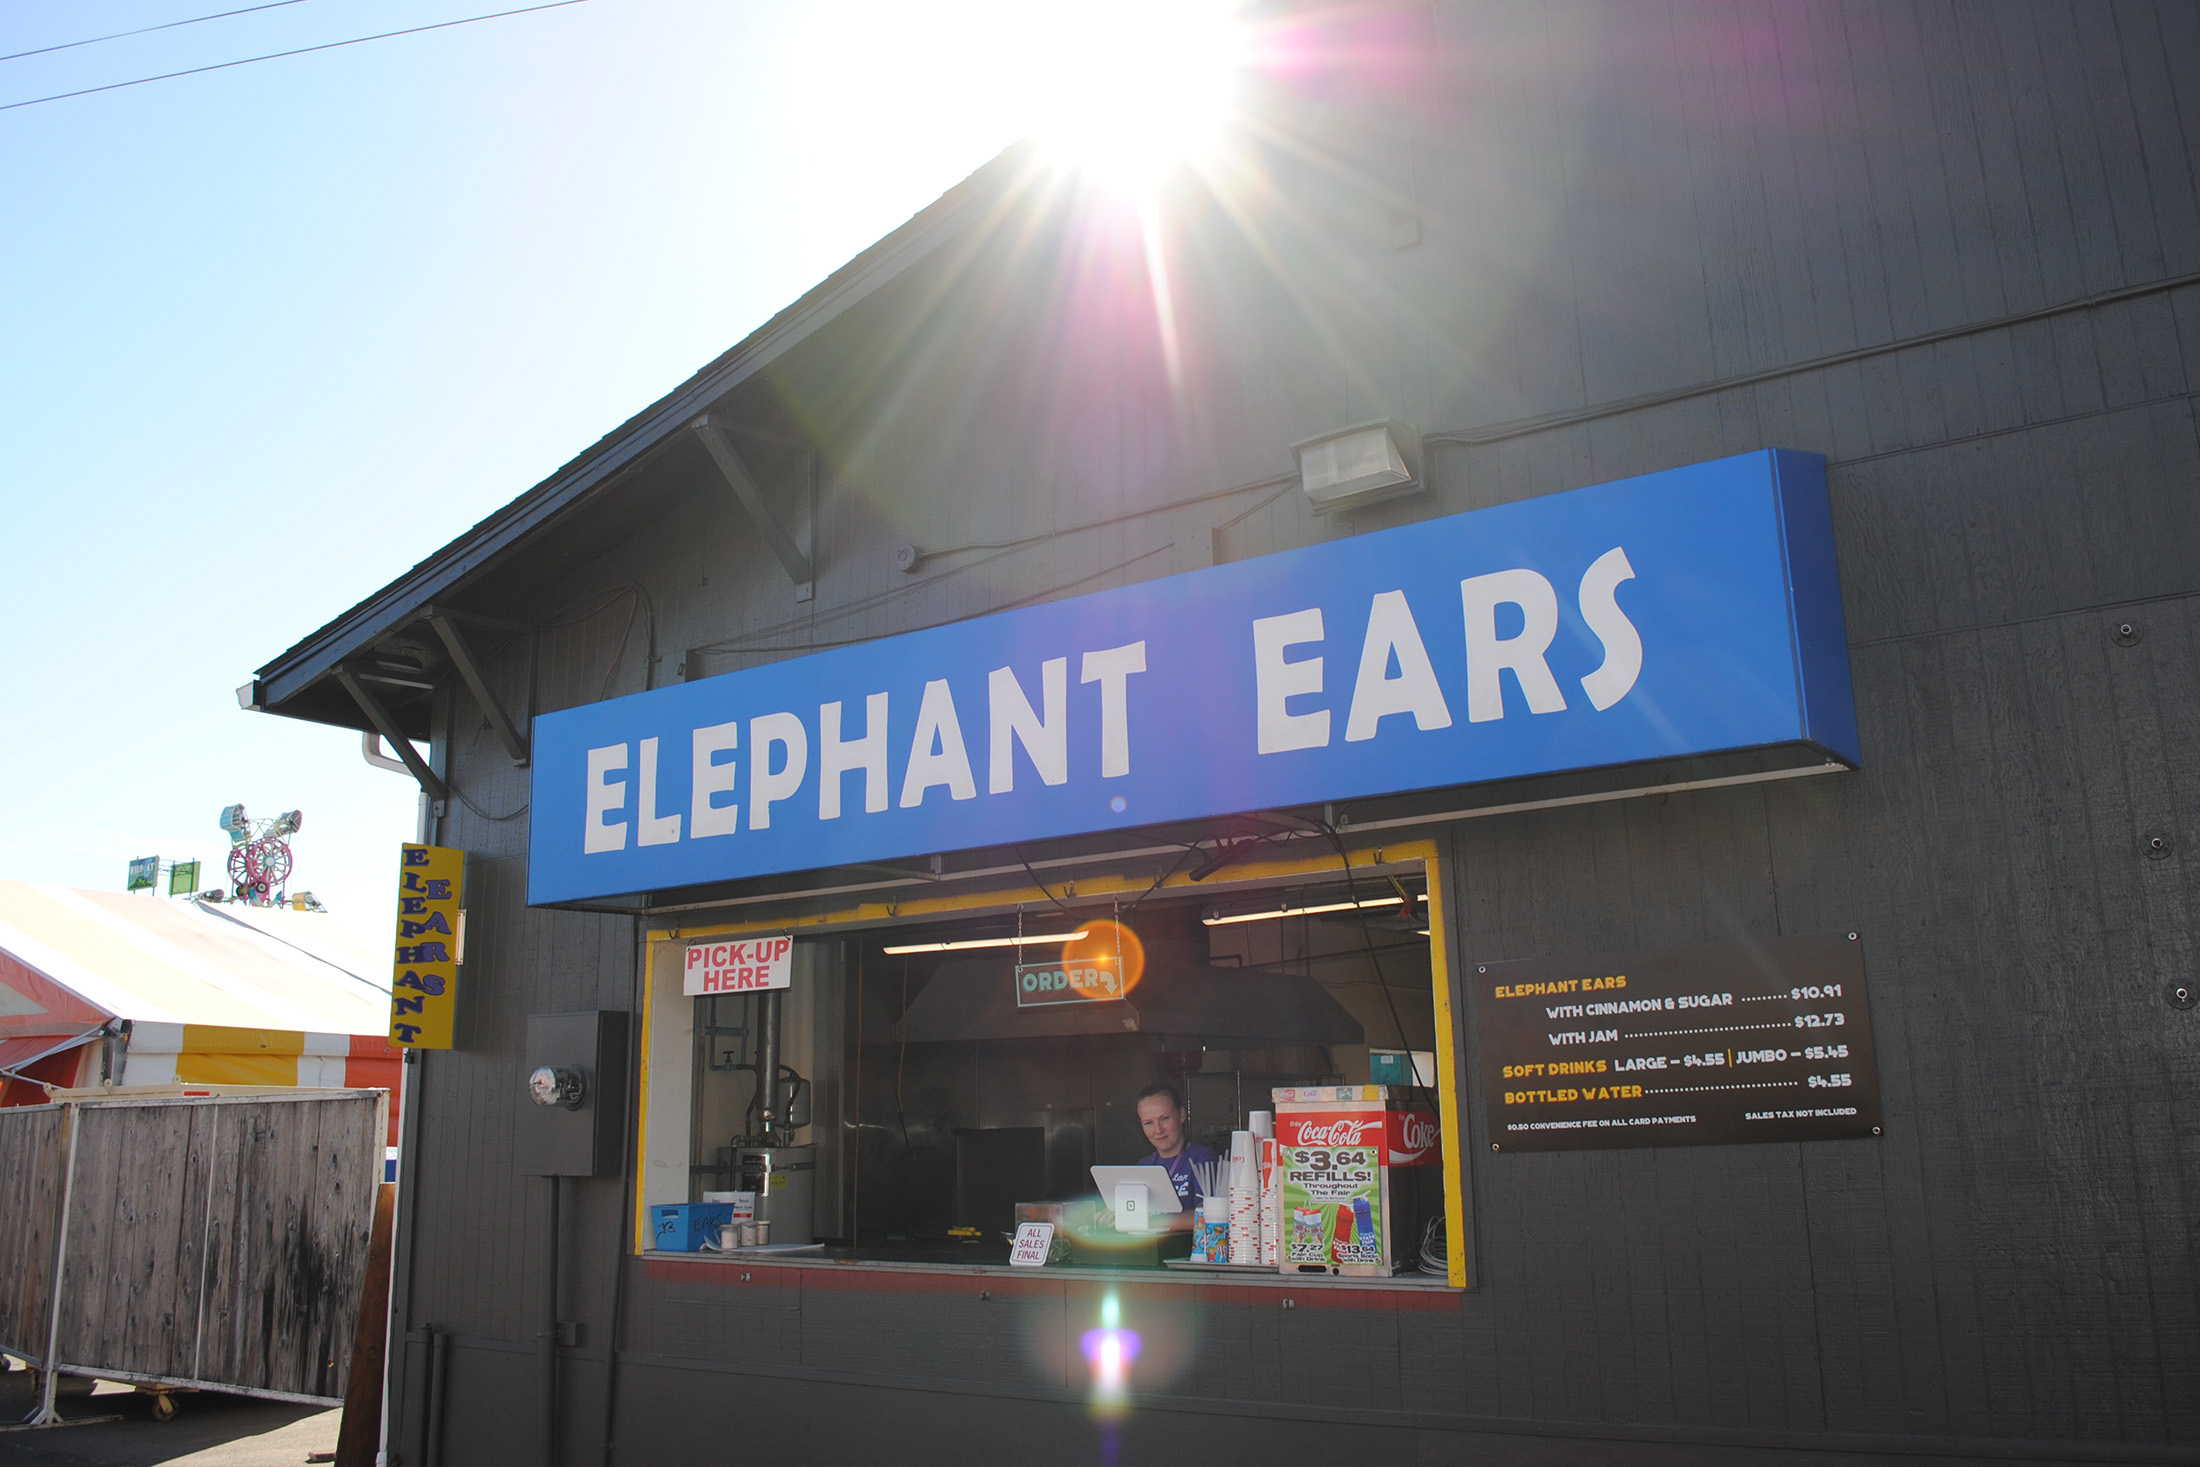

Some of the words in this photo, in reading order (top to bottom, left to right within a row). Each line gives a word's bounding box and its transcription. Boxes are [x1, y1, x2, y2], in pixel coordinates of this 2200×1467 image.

[584, 640, 1147, 854] ELEPHANT
[1253, 546, 1642, 754] EARS
[394, 849, 430, 1043] ELEPHANT
[420, 879, 452, 996] EARS
[688, 939, 789, 970] PICK-UP
[703, 965, 770, 992] HERE
[1022, 968, 1098, 992] ORDER
[1495, 980, 1578, 998] ELEPHANT
[1582, 975, 1627, 992] EARS
[1546, 1005, 1583, 1019] WITH
[1586, 999, 1662, 1016] CINNAMON
[1664, 998, 1675, 1010] &
[1678, 993, 1733, 1009] SUGAR
[1791, 984, 1843, 1000] $10.91
[1549, 1032, 1586, 1046] WITH
[1589, 1029, 1618, 1043] JAM
[1794, 1013, 1845, 1028] $12.73
[1502, 1064, 1545, 1078] SOFT
[1549, 1060, 1607, 1075] DRINKS
[1614, 1057, 1667, 1071] LARGE
[1684, 1053, 1725, 1067] $4.55
[1736, 1049, 1787, 1064] JUMBO
[1805, 1045, 1849, 1060] $5.45
[1504, 1089, 1578, 1104] BOTTLED
[1581, 1085, 1643, 1100] WATER
[1808, 1074, 1852, 1088] $4.55
[1507, 1123, 1528, 1131] $0.50
[1530, 1121, 1581, 1131] CONVENIENCE
[1582, 1119, 1598, 1128] FEE
[1599, 1118, 1610, 1127] ON
[1611, 1117, 1628, 1126] ALL
[1629, 1116, 1651, 1125] CARD
[1652, 1114, 1697, 1124] PAYMENTS
[1745, 1111, 1774, 1120] SALES
[1775, 1110, 1795, 1119] TAX
[1796, 1109, 1813, 1118] NOT
[1814, 1107, 1857, 1117] INCLUDED
[1297, 1119, 1365, 1147] Coca-Cola
[1403, 1113, 1435, 1149] Coke
[1294, 1150, 1366, 1171] $3.64
[1289, 1171, 1371, 1181] REFILLS!
[1019, 1239, 1044, 1248] SALES
[1026, 1229, 1041, 1237] ALL
[1017, 1250, 1039, 1260] FINAL
[1291, 1244, 1323, 1253] $7.27
[1341, 1245, 1375, 1254] $13.64
